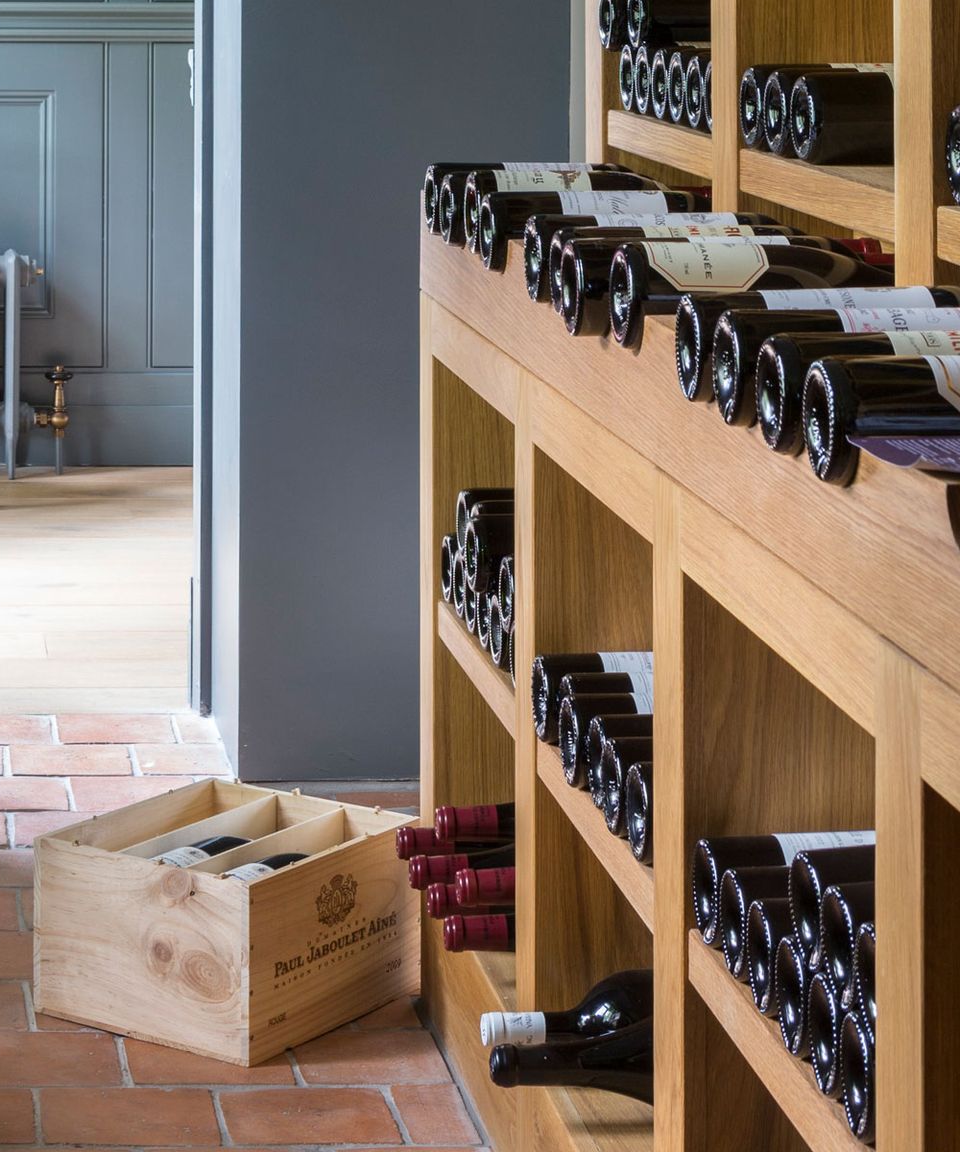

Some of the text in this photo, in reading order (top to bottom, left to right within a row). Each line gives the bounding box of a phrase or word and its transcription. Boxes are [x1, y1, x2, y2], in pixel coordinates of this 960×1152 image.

[274, 911, 397, 979] PAUL JABOULET AÎNÉ
[274, 969, 311, 989] MAISON
[361, 942, 372, 951] EN
